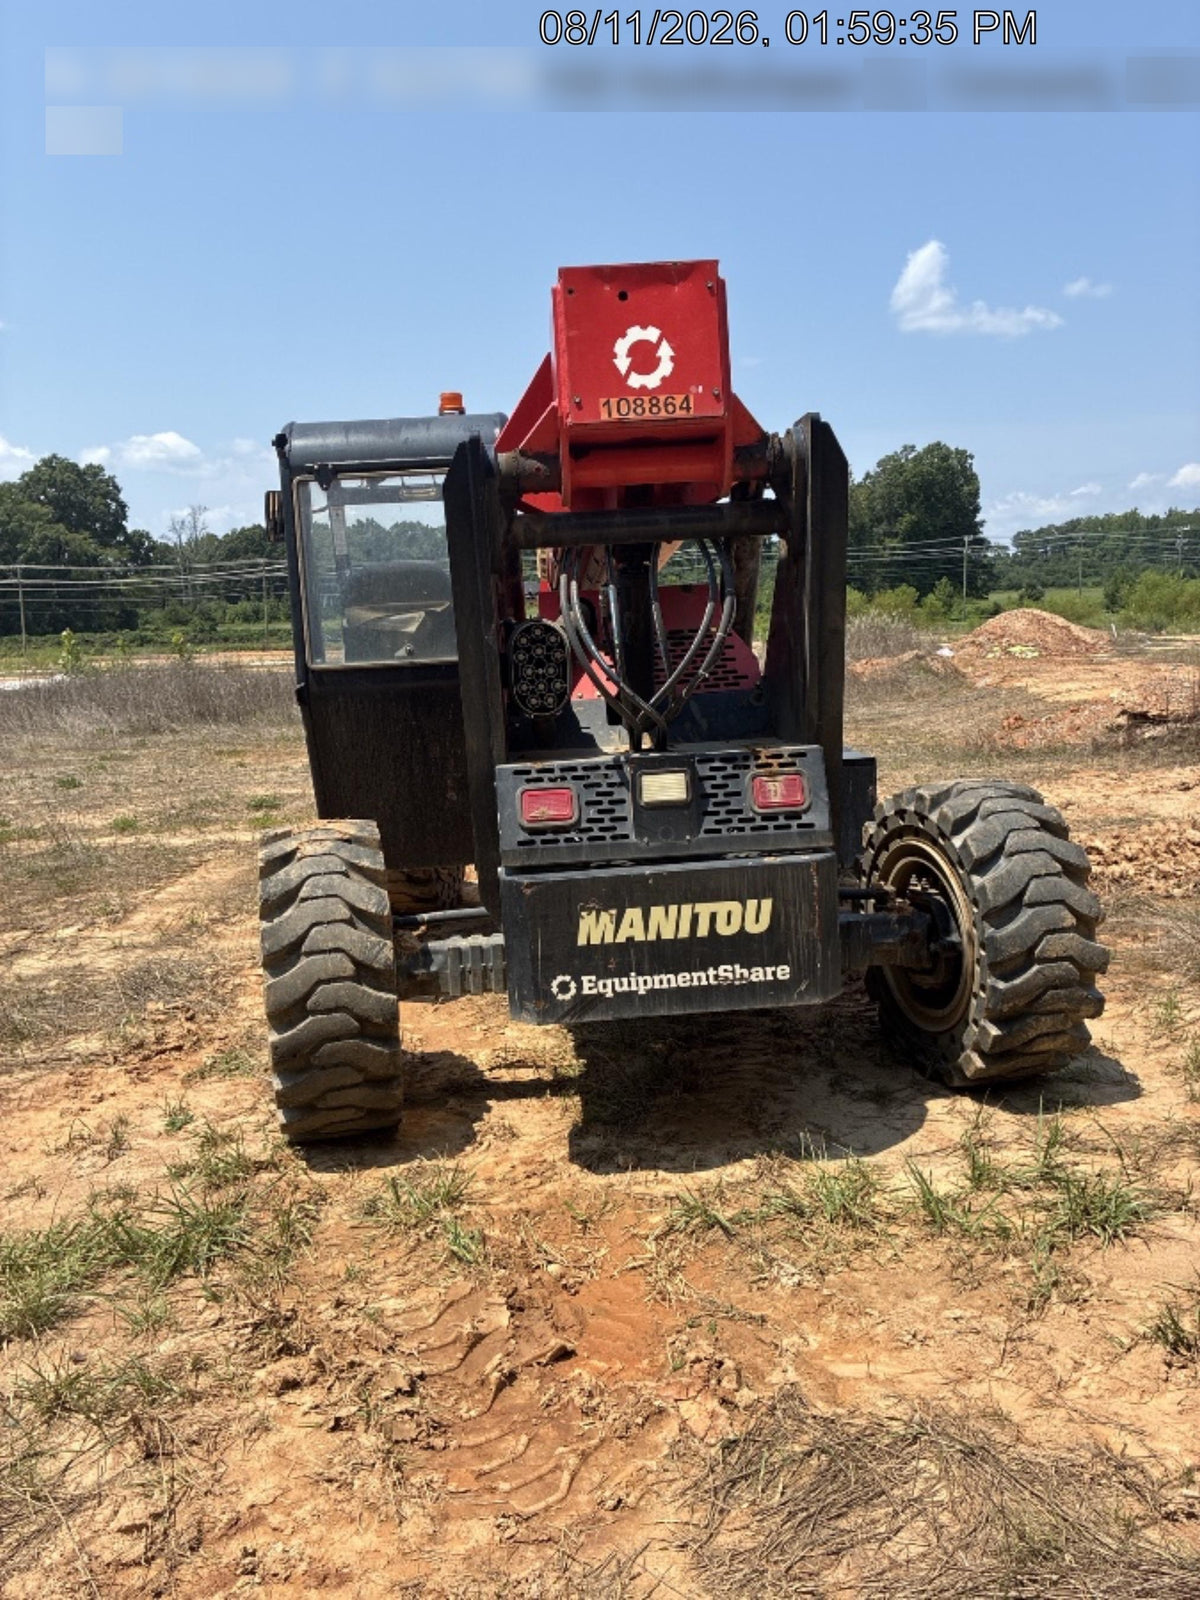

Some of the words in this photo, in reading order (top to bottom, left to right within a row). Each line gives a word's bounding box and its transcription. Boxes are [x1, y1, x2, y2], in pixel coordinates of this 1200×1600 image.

[602, 396, 692, 418] 108864
[577, 899, 773, 946] MANITOU
[581, 965, 790, 997] EquipmentShare
